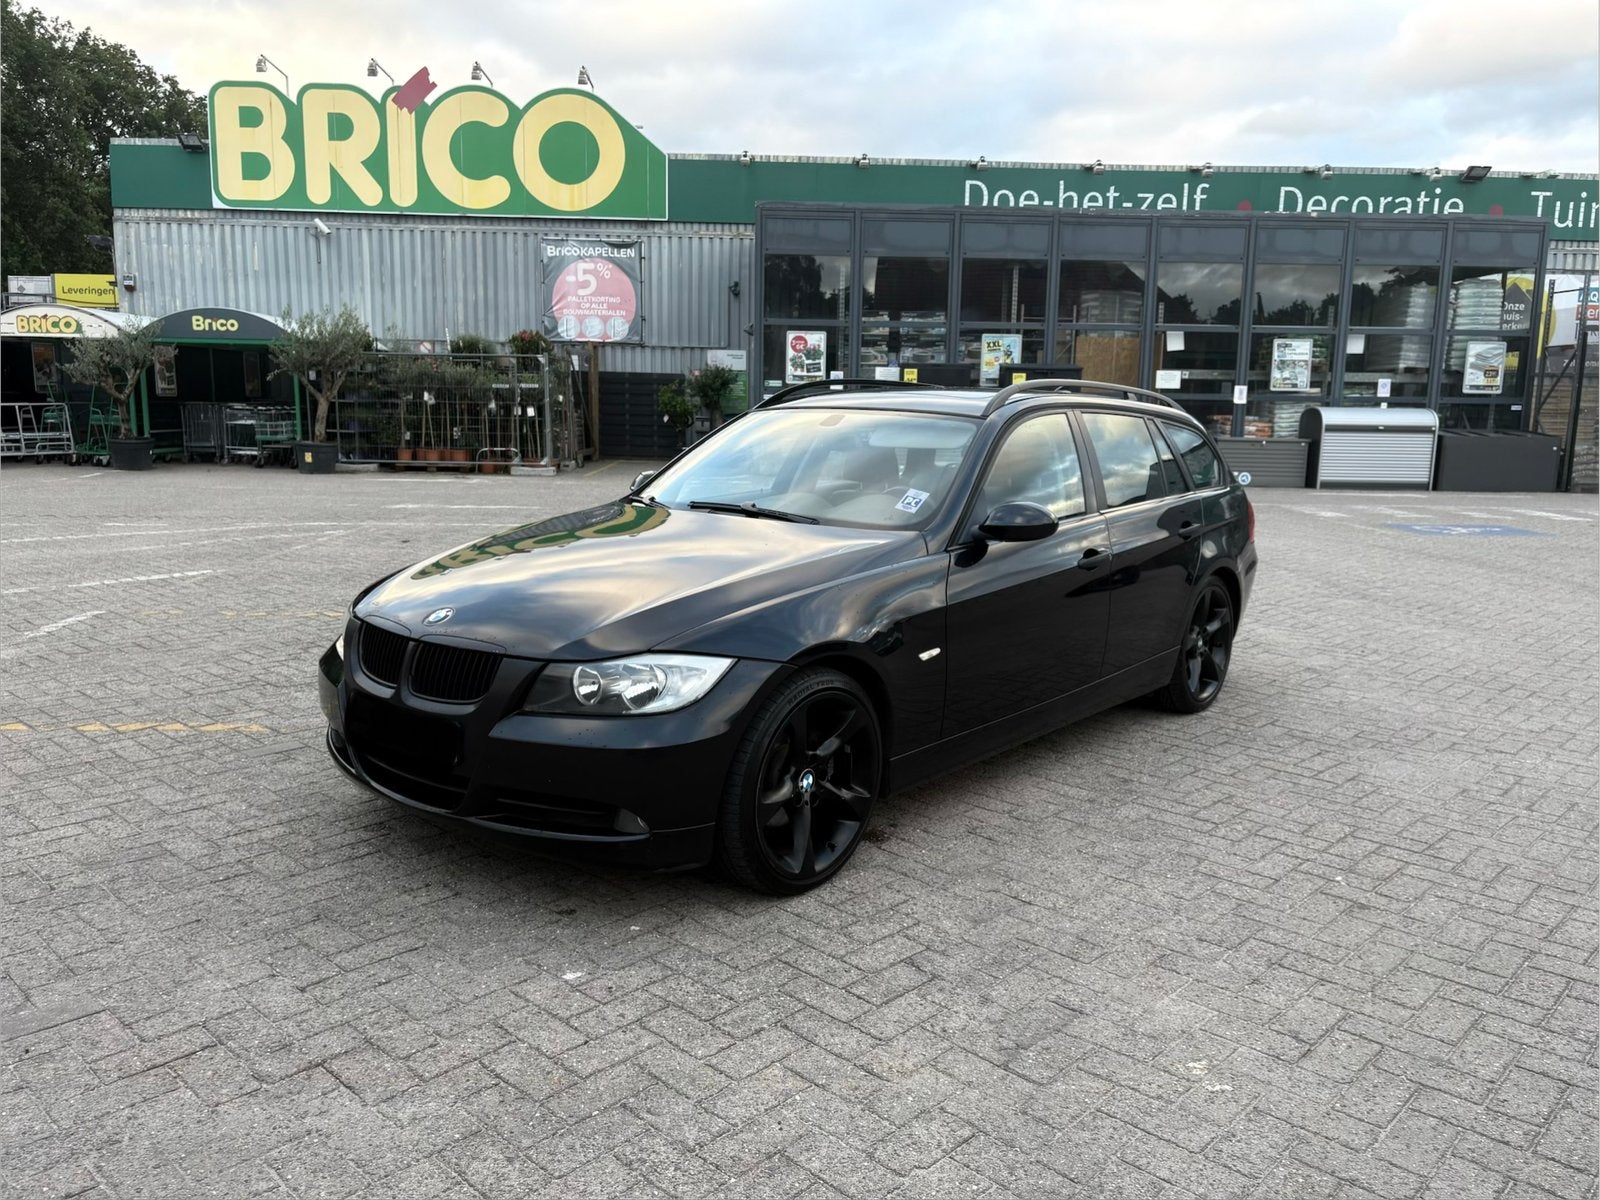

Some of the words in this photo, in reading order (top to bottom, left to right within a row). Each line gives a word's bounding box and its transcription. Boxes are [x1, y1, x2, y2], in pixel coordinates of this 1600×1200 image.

[213, 84, 625, 211] BRICO
[964, 179, 1210, 211] Doe-het-zelf
[1278, 186, 1465, 214] Decoratie
[62, 285, 115, 297] Leveringen
[17, 314, 77, 333] BRICO
[191, 315, 239, 331] Brico
[986, 340, 1002, 349] XXL
